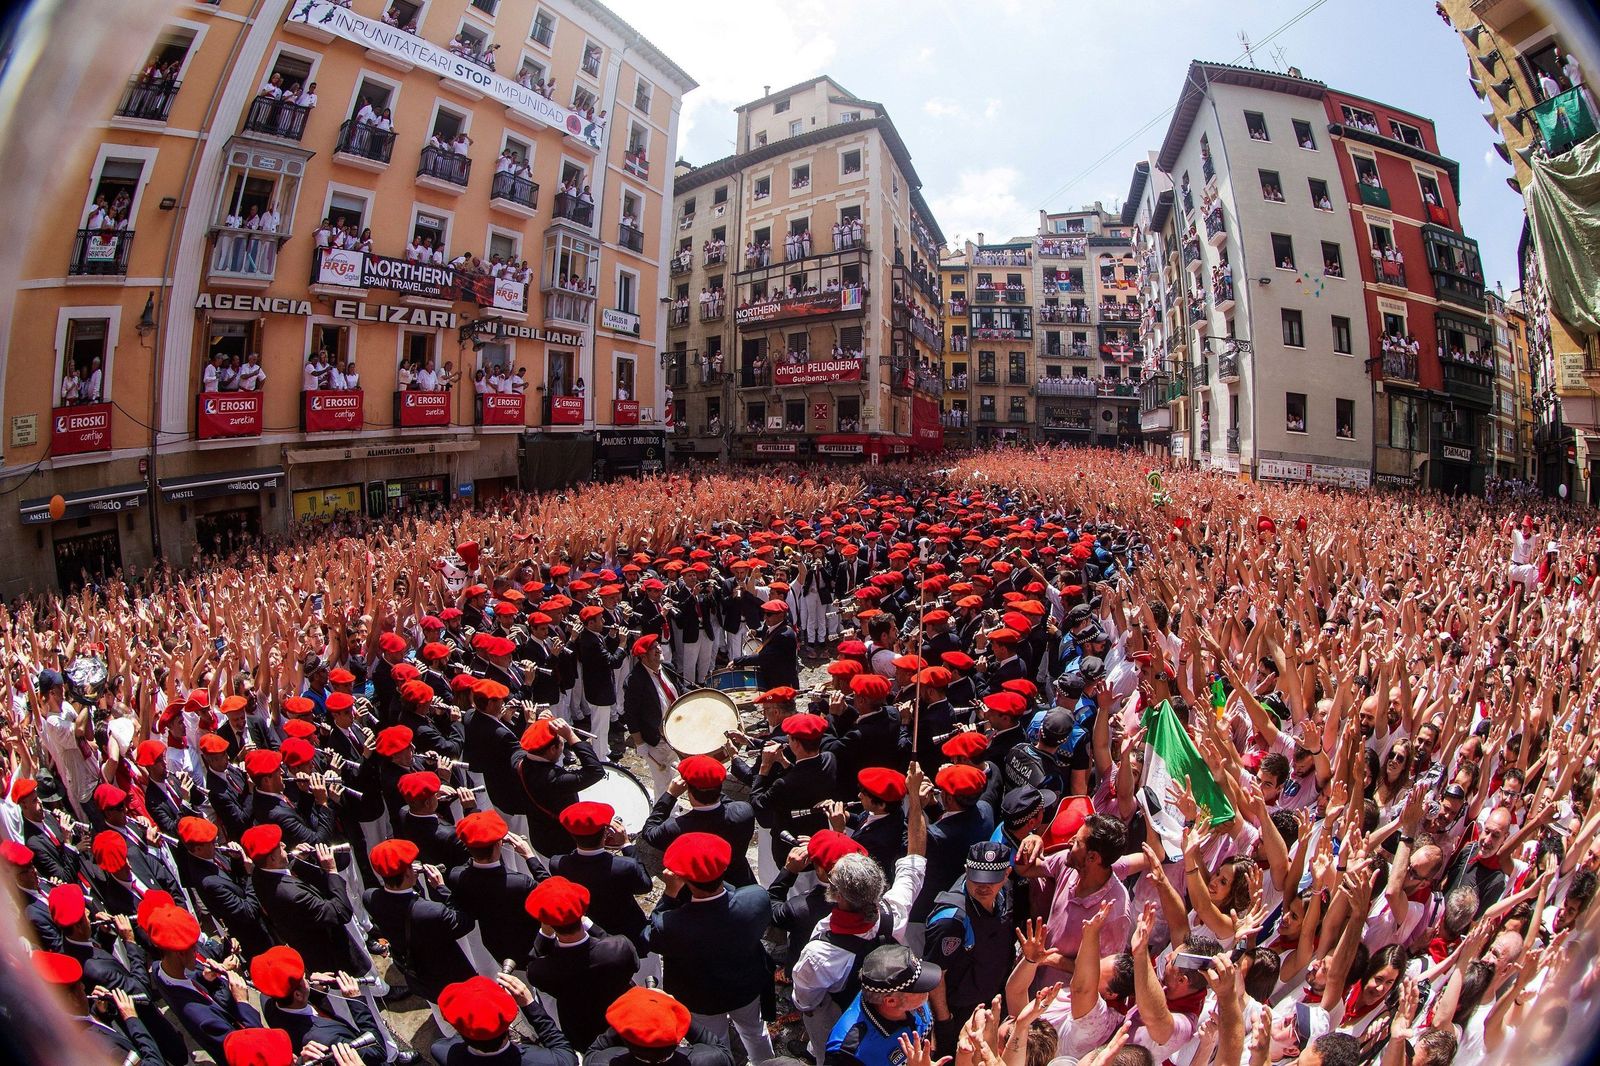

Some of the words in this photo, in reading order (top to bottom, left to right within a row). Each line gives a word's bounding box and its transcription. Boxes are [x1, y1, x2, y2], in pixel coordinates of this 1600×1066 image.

[335, 14, 452, 71] INPUNITATEARI
[454, 64, 491, 87] STOP
[494, 81, 563, 123] IMPUNIDAD
[322, 261, 355, 275] ARGA
[365, 258, 453, 286] NORTHERN
[363, 275, 389, 287] SPAIN
[496, 290, 518, 301] ARGA
[195, 292, 312, 316] AGENCIA
[334, 300, 457, 329] ELIZARI
[736, 303, 781, 319] NORTHERN
[807, 360, 860, 373] PELUQUERIA
[220, 400, 255, 411] EROSKI
[325, 398, 356, 407] EROSKI
[418, 396, 445, 405] EROSKI
[562, 400, 581, 408] EROSKI
[230, 415, 255, 425] zurekin
[335, 409, 356, 422] contigo
[71, 415, 105, 429] EROSKI
[80, 430, 103, 446] contigo
[601, 437, 627, 446] JAMONES
[633, 436, 660, 445] EMBUTIDOS
[171, 490, 194, 500] AMSTEL
[29, 512, 51, 521] AMSTEL
